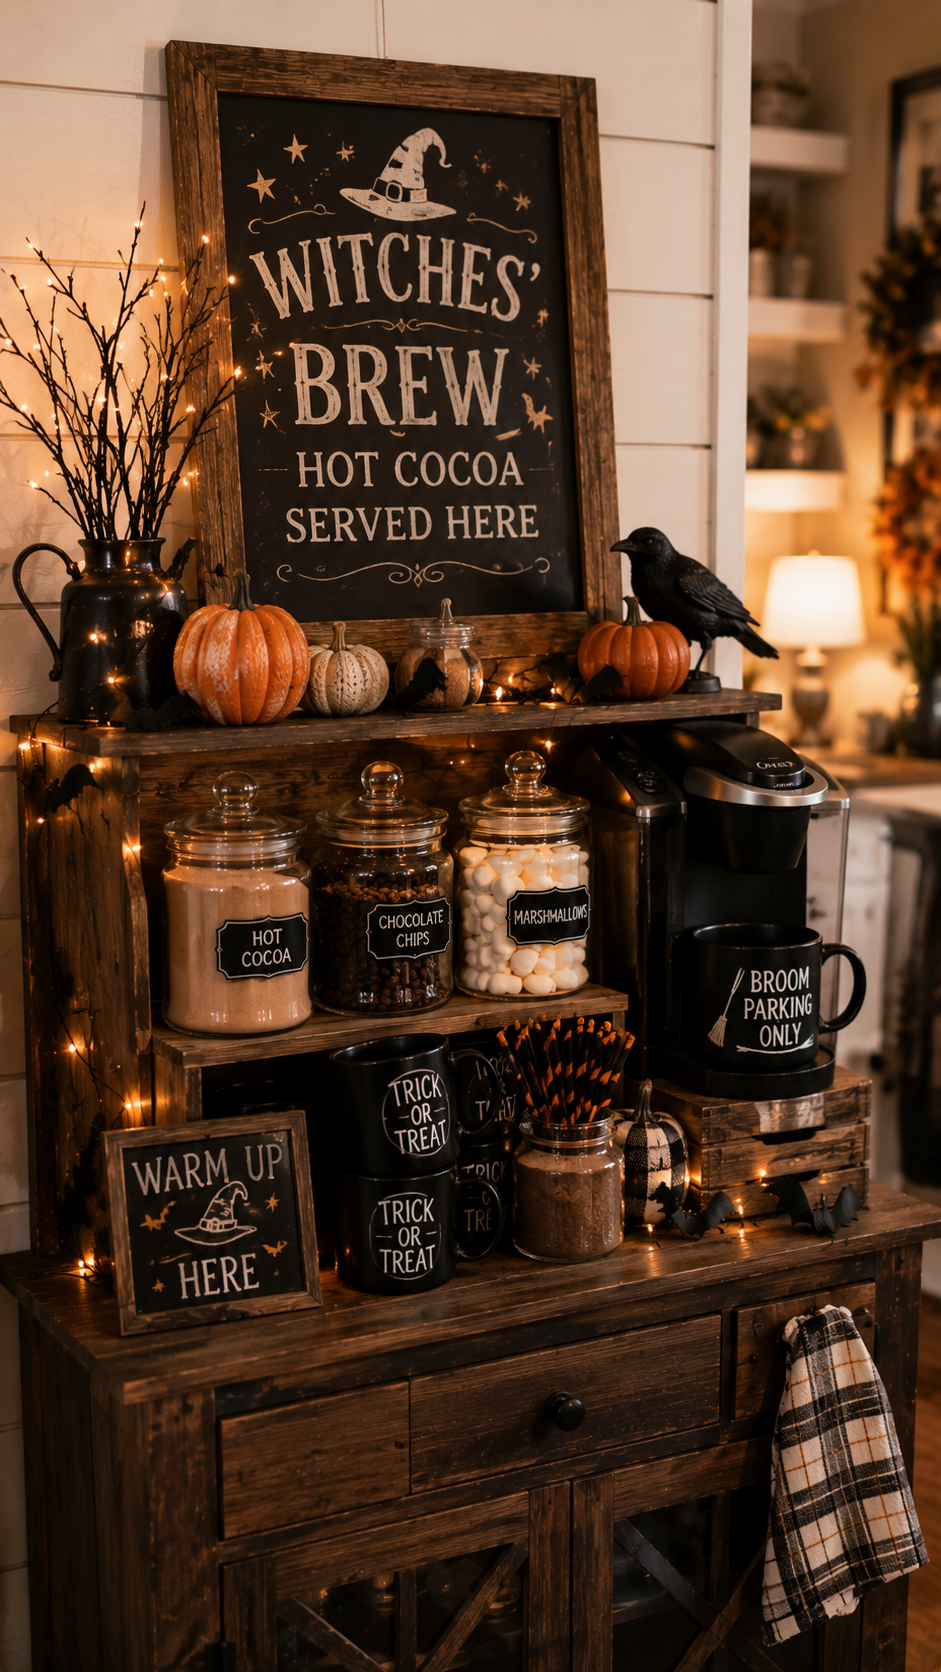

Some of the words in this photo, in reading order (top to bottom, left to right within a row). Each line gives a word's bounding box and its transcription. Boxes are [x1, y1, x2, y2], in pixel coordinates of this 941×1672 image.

[249, 232, 541, 322] WITCHES'
[289, 342, 509, 426] BREW
[296, 451, 378, 487] HOT
[395, 451, 524, 486] COCOA
[286, 507, 432, 543] SERVED
[446, 505, 539, 539] HERE
[379, 909, 443, 930] CHOCOLATE
[514, 904, 588, 925] MARSHMALLOWS
[252, 928, 283, 947] HOT
[396, 930, 430, 948] CHIPS
[241, 947, 292, 967] COCOA
[751, 966, 810, 992] BROOM
[743, 993, 812, 1020] PARKING
[759, 1021, 802, 1047] ONLY
[388, 1073, 442, 1107] TRICK
[410, 1102, 432, 1126] OR
[394, 1119, 447, 1155] TREAT
[132, 1147, 229, 1196] WARM
[245, 1143, 283, 1181] UP
[377, 1197, 435, 1226] TRICK
[398, 1226, 422, 1247] OR
[379, 1244, 436, 1274] TREAT
[177, 1253, 260, 1300] HERE
